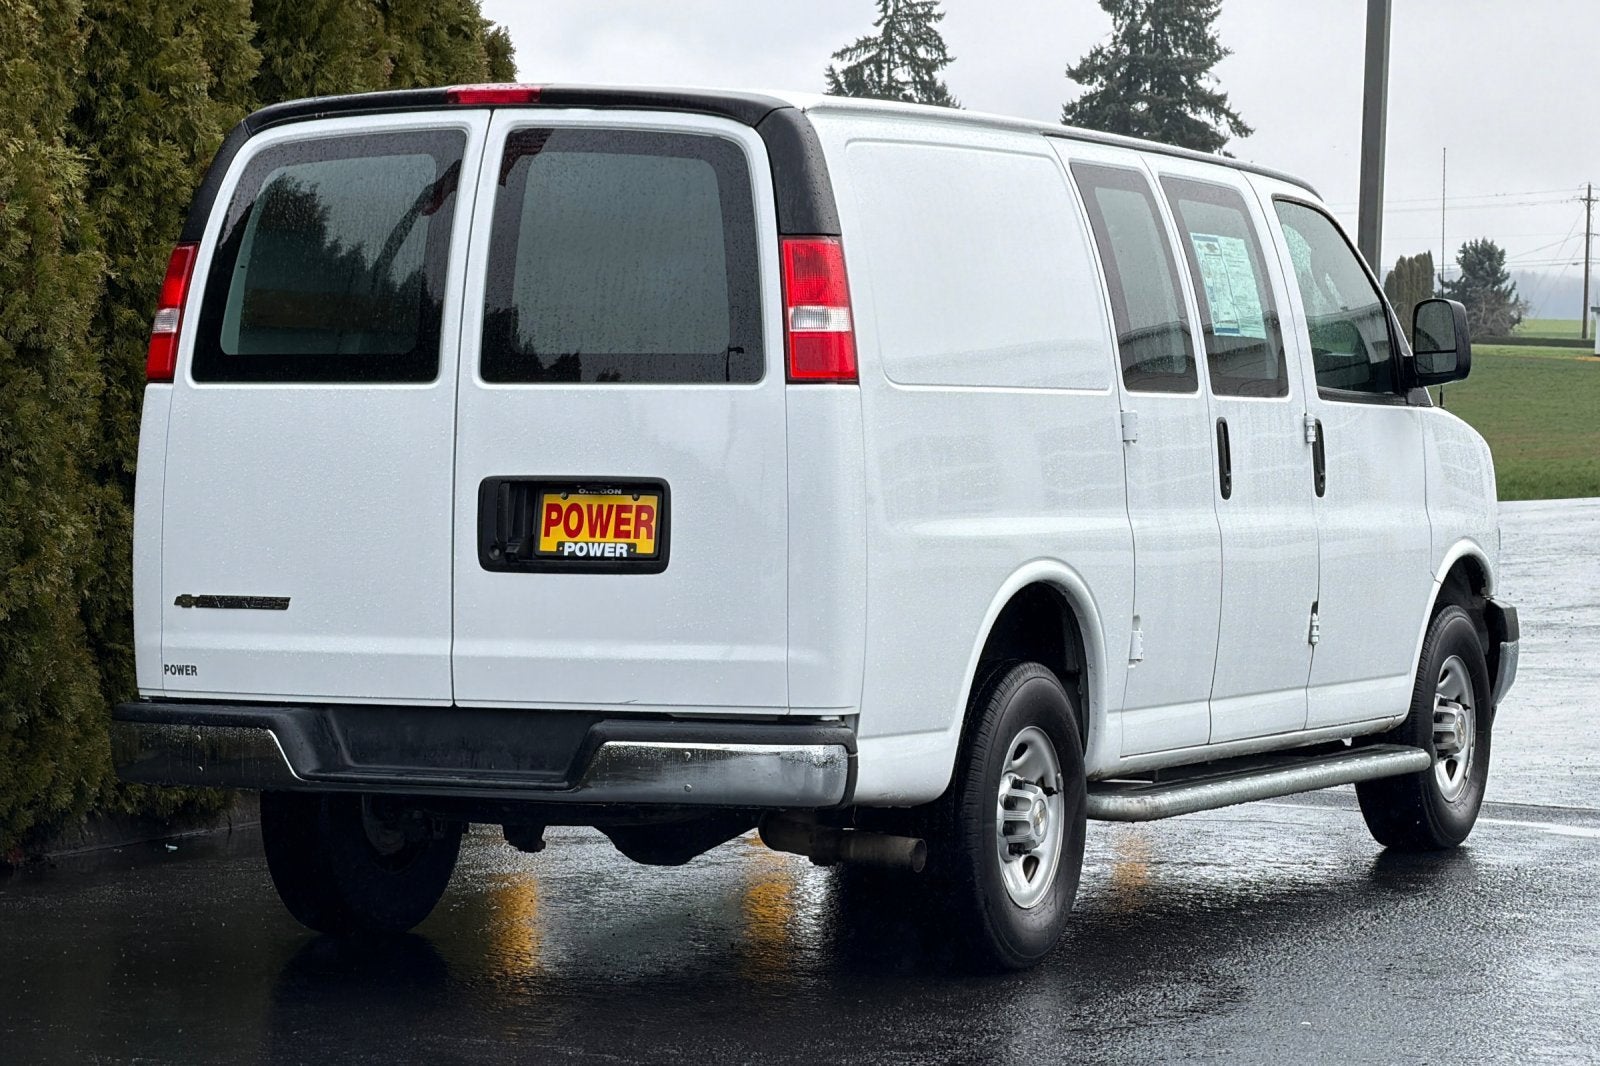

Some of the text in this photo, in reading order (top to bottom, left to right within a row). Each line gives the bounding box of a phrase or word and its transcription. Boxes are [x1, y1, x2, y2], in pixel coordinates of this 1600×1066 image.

[543, 502, 656, 540] POWER
[563, 542, 628, 558] POWER
[163, 664, 198, 677] POWER
